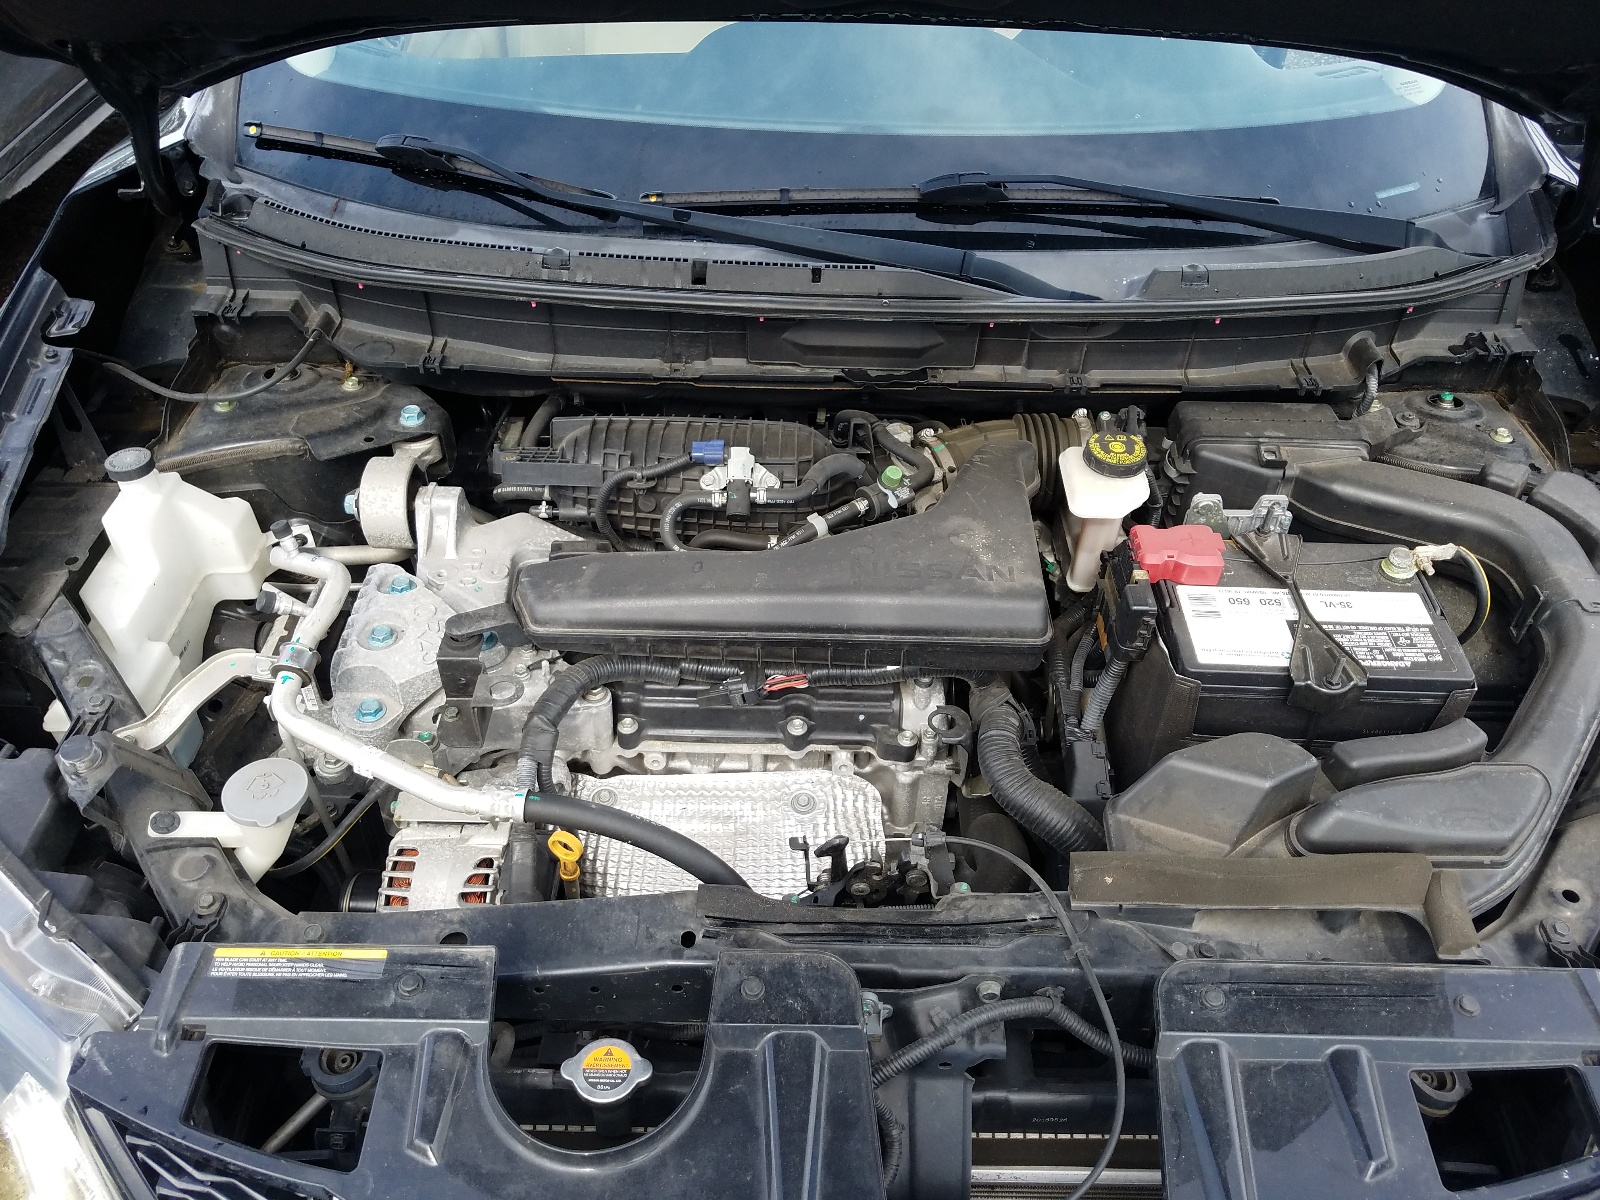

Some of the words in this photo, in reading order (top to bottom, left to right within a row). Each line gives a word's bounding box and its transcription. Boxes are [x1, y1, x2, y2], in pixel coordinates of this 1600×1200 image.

[850, 561, 1017, 582] NISSAN
[1228, 597, 1251, 606] 650
[1259, 598, 1282, 606] 520
[1320, 601, 1353, 609] 35-VL
